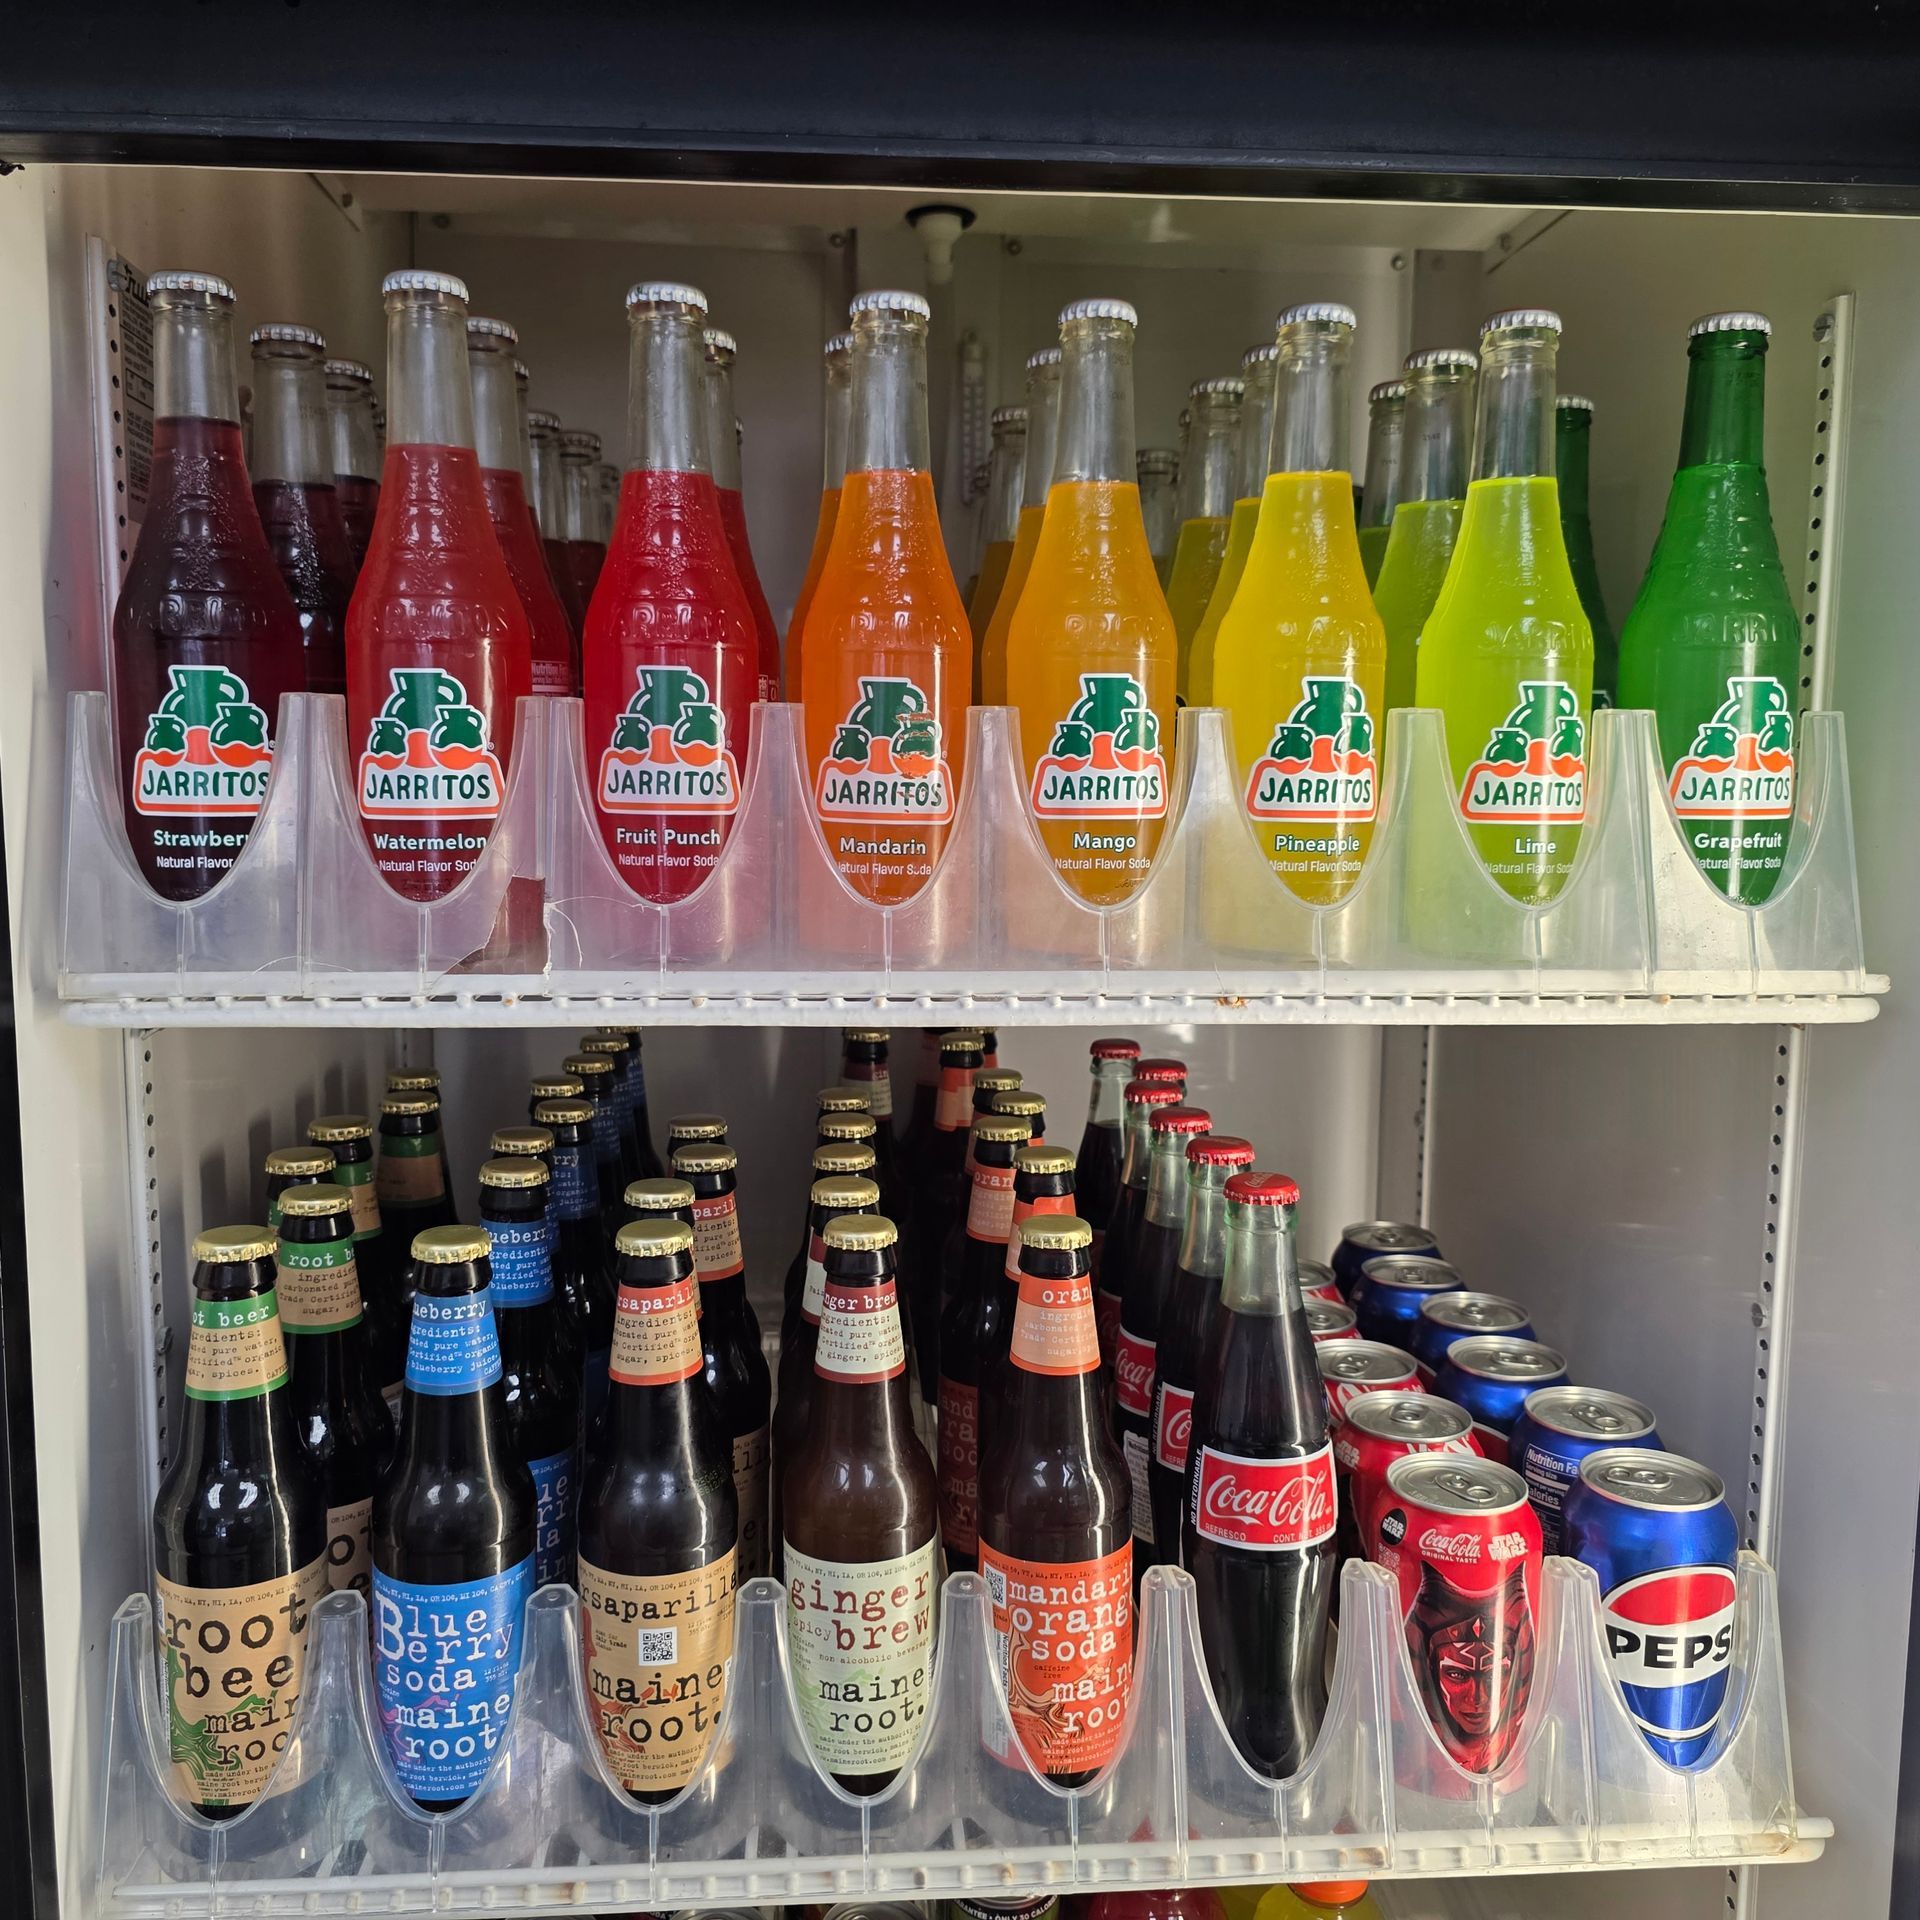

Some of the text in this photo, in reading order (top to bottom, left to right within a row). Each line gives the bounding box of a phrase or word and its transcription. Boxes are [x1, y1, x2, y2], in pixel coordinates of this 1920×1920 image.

[143, 769, 270, 797] JARRITOS
[366, 773, 491, 800] JARRITOS
[608, 769, 728, 796] JARRITOS
[1044, 775, 1159, 800] JARRITOS
[1260, 777, 1371, 804] JARRITOS
[1681, 777, 1790, 801] JARRITOS
[825, 778, 942, 807] JARRITOS
[1474, 781, 1582, 806] JARRITOS
[153, 830, 249, 847] Strawber
[373, 833, 487, 850] Watermelon
[616, 828, 721, 845] Fruit Punch
[1073, 833, 1137, 852] Mango
[1275, 835, 1360, 856] Pineapple
[1694, 832, 1782, 851] Grapefruit
[840, 837, 926, 855] Mandarin
[1515, 838, 1556, 854] Lime
[156, 856, 233, 869] Natural Flavor
[379, 860, 451, 872] Natural Flavor
[619, 854, 654, 866] Natural
[657, 855, 690, 867] Flavor
[838, 862, 869, 874] atural
[872, 864, 903, 875] Flavor
[1055, 858, 1150, 870] Natural Flavor Soda
[1311, 861, 1340, 872] Flavor
[1342, 860, 1361, 871] Soda
[1527, 863, 1554, 874] Flavor
[1697, 857, 1781, 870] atural Flavor Soda
[974, 1170, 1013, 1187] oran
[289, 1253, 333, 1267] root
[517, 1261, 536, 1270] pure
[284, 1283, 338, 1292] carbonated
[490, 1281, 540, 1290] blueberry
[1042, 1286, 1090, 1303] oran
[825, 1291, 896, 1310] nger brew
[218, 1306, 269, 1327] beer
[414, 1300, 486, 1320] ueberry
[655, 1329, 676, 1340] pure
[850, 1330, 872, 1340] pure
[212, 1346, 237, 1356] pure
[434, 1343, 458, 1351] pure
[827, 1351, 867, 1362] ginger,
[412, 1360, 463, 1374] blueberry
[1527, 1449, 1564, 1471] Nutrition
[1526, 1462, 1557, 1480] Serving size
[1190, 1448, 1203, 1526] NO RETORNABLE
[1529, 1487, 1559, 1505] alories
[1205, 1469, 1328, 1527] Coca-Cola
[1205, 1522, 1246, 1541] REFRESCO
[1273, 1533, 1296, 1543] CONT.
[1382, 1523, 1404, 1539] WARS
[1383, 1516, 1404, 1531] STAR
[1418, 1528, 1482, 1557] Coca-Cola
[1491, 1532, 1526, 1549] STAR
[1422, 1550, 1478, 1564] ORIGINAL TASTE
[1488, 1544, 1529, 1561] WARS
[580, 1570, 737, 1623] rsaparilla
[791, 1570, 929, 1621] ginger
[167, 1593, 307, 1653] root
[1011, 1594, 1129, 1636] orang
[793, 1616, 831, 1641] spicy
[832, 1605, 930, 1651] brew
[1031, 1630, 1116, 1662] soda
[1605, 1624, 1732, 1669] PEPS
[819, 1654, 835, 1663] non
[840, 1654, 892, 1664] alcoholic
[179, 1653, 295, 1698] bee
[387, 1664, 477, 1693] soda
[592, 1663, 723, 1704] maine
[819, 1668, 924, 1702] maine
[395, 1694, 510, 1729] maine
[830, 1698, 924, 1732] root.
[216, 1731, 289, 1765] roo
[405, 1723, 497, 1760] root
[227, 1769, 251, 1777] under
[255, 1765, 268, 1773] the
[414, 1764, 434, 1772] under
